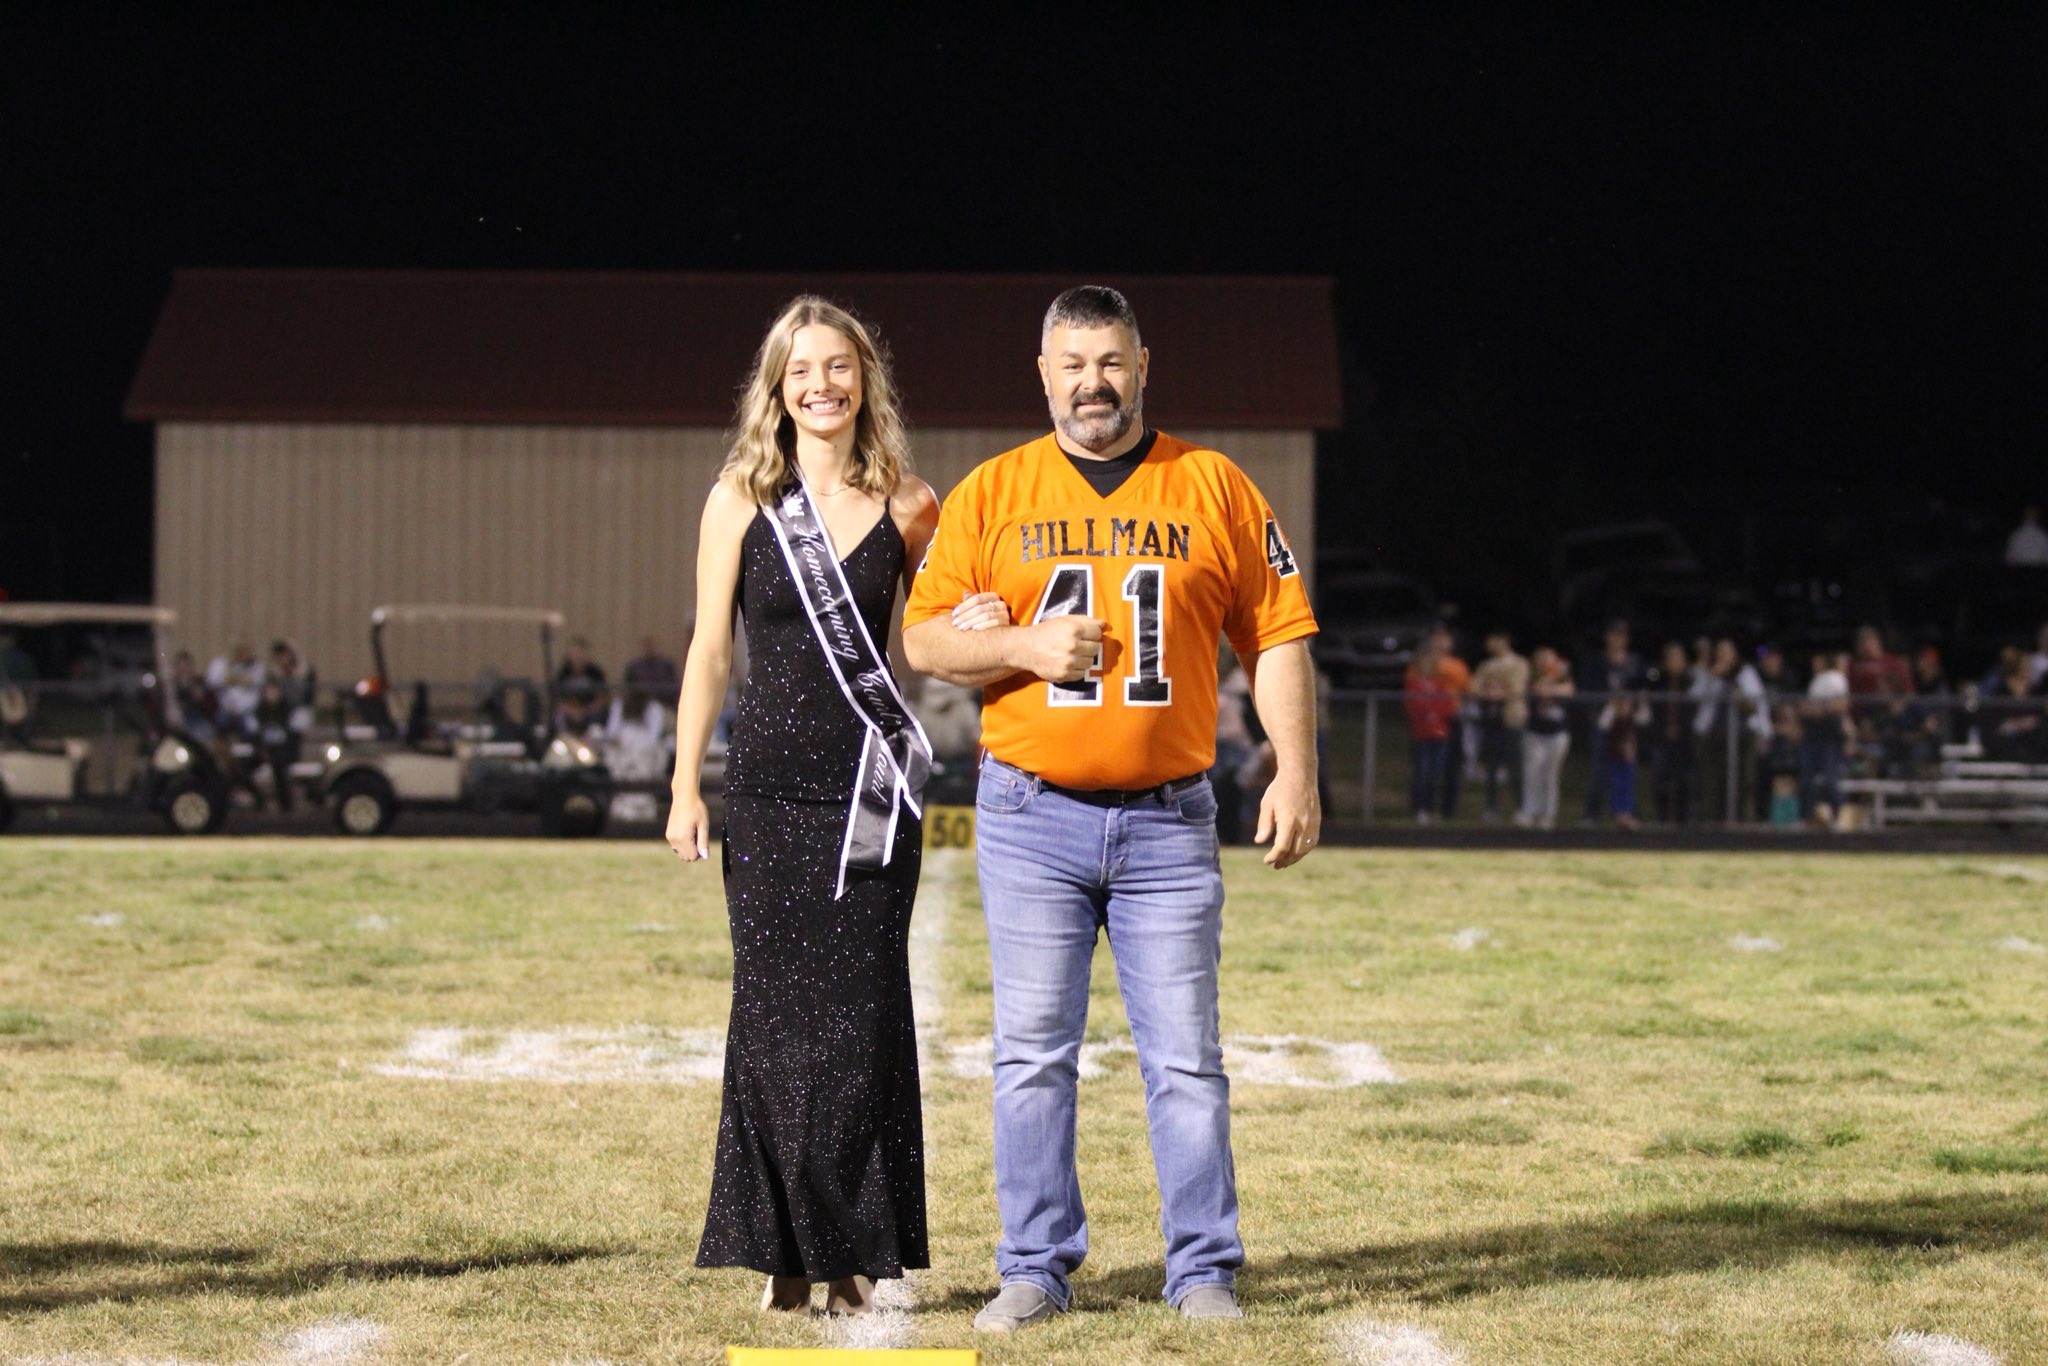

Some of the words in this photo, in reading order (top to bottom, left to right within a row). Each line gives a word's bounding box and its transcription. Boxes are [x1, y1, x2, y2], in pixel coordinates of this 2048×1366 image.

[1020, 517, 1191, 563] HILLMAN
[793, 523, 860, 663] Homecoming
[1031, 563, 1173, 707] 41
[871, 752, 889, 804] ourt
[931, 814, 972, 849] 50
